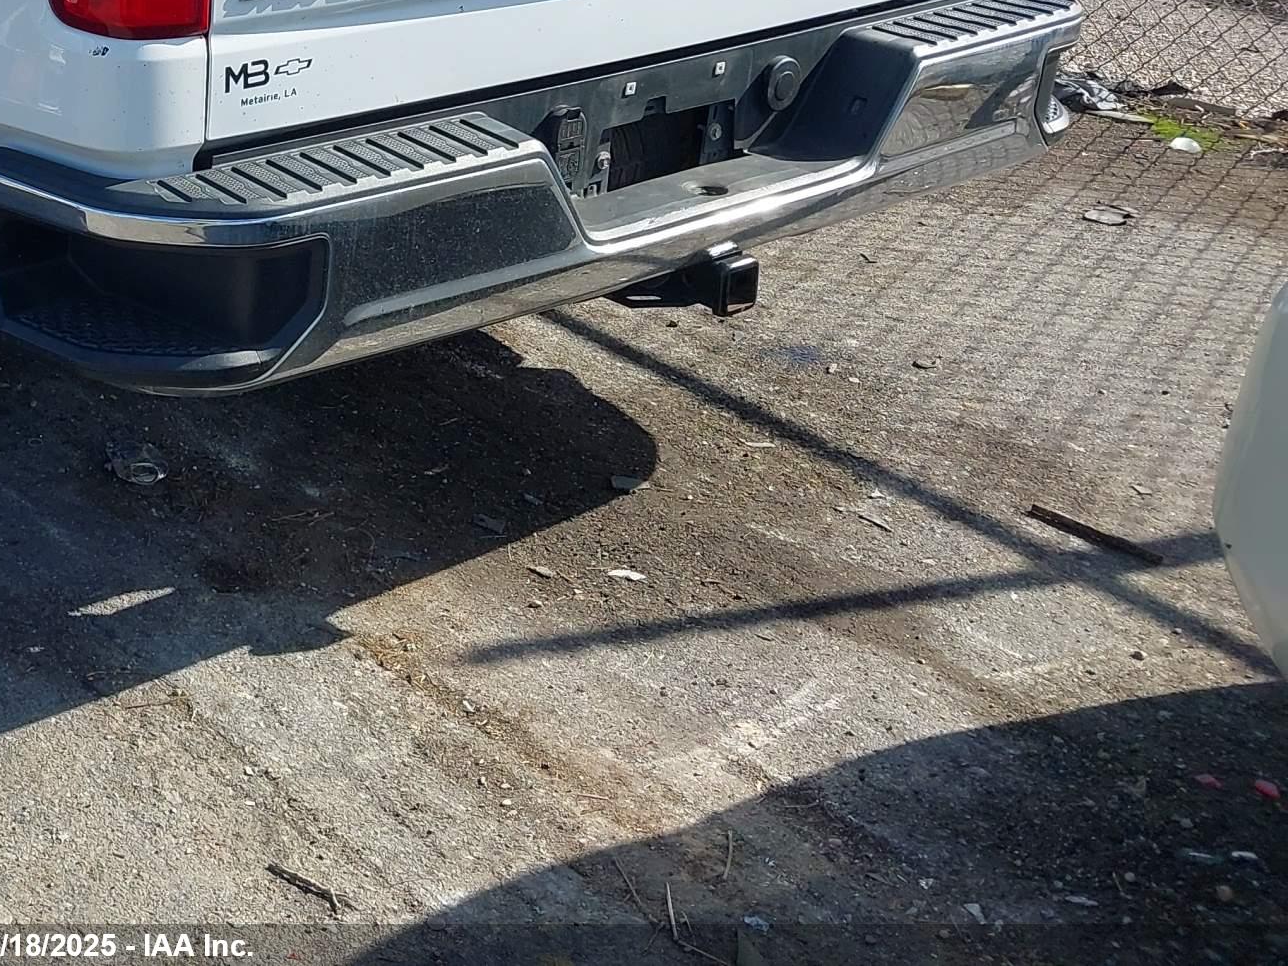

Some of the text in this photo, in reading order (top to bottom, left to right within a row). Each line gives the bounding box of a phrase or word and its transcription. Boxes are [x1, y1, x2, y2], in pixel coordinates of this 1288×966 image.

[225, 60, 270, 93] MB
[241, 87, 297, 106] Metairie, LA
